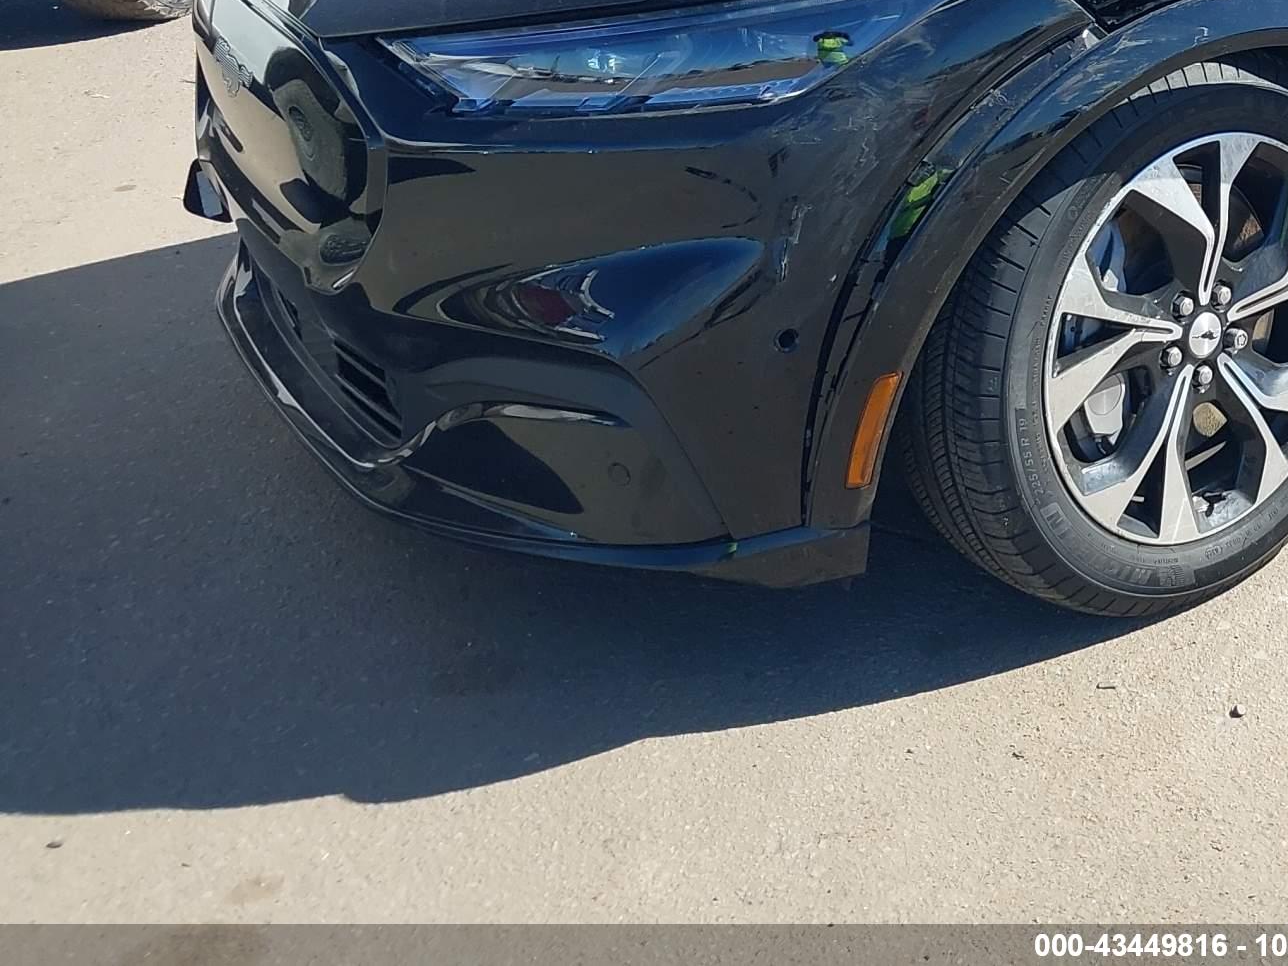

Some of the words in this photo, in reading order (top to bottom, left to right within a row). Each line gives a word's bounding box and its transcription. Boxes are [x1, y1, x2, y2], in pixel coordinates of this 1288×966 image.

[1019, 418, 1028, 431] 19
[1021, 437, 1031, 447] R
[1024, 451, 1044, 496] 225/55
